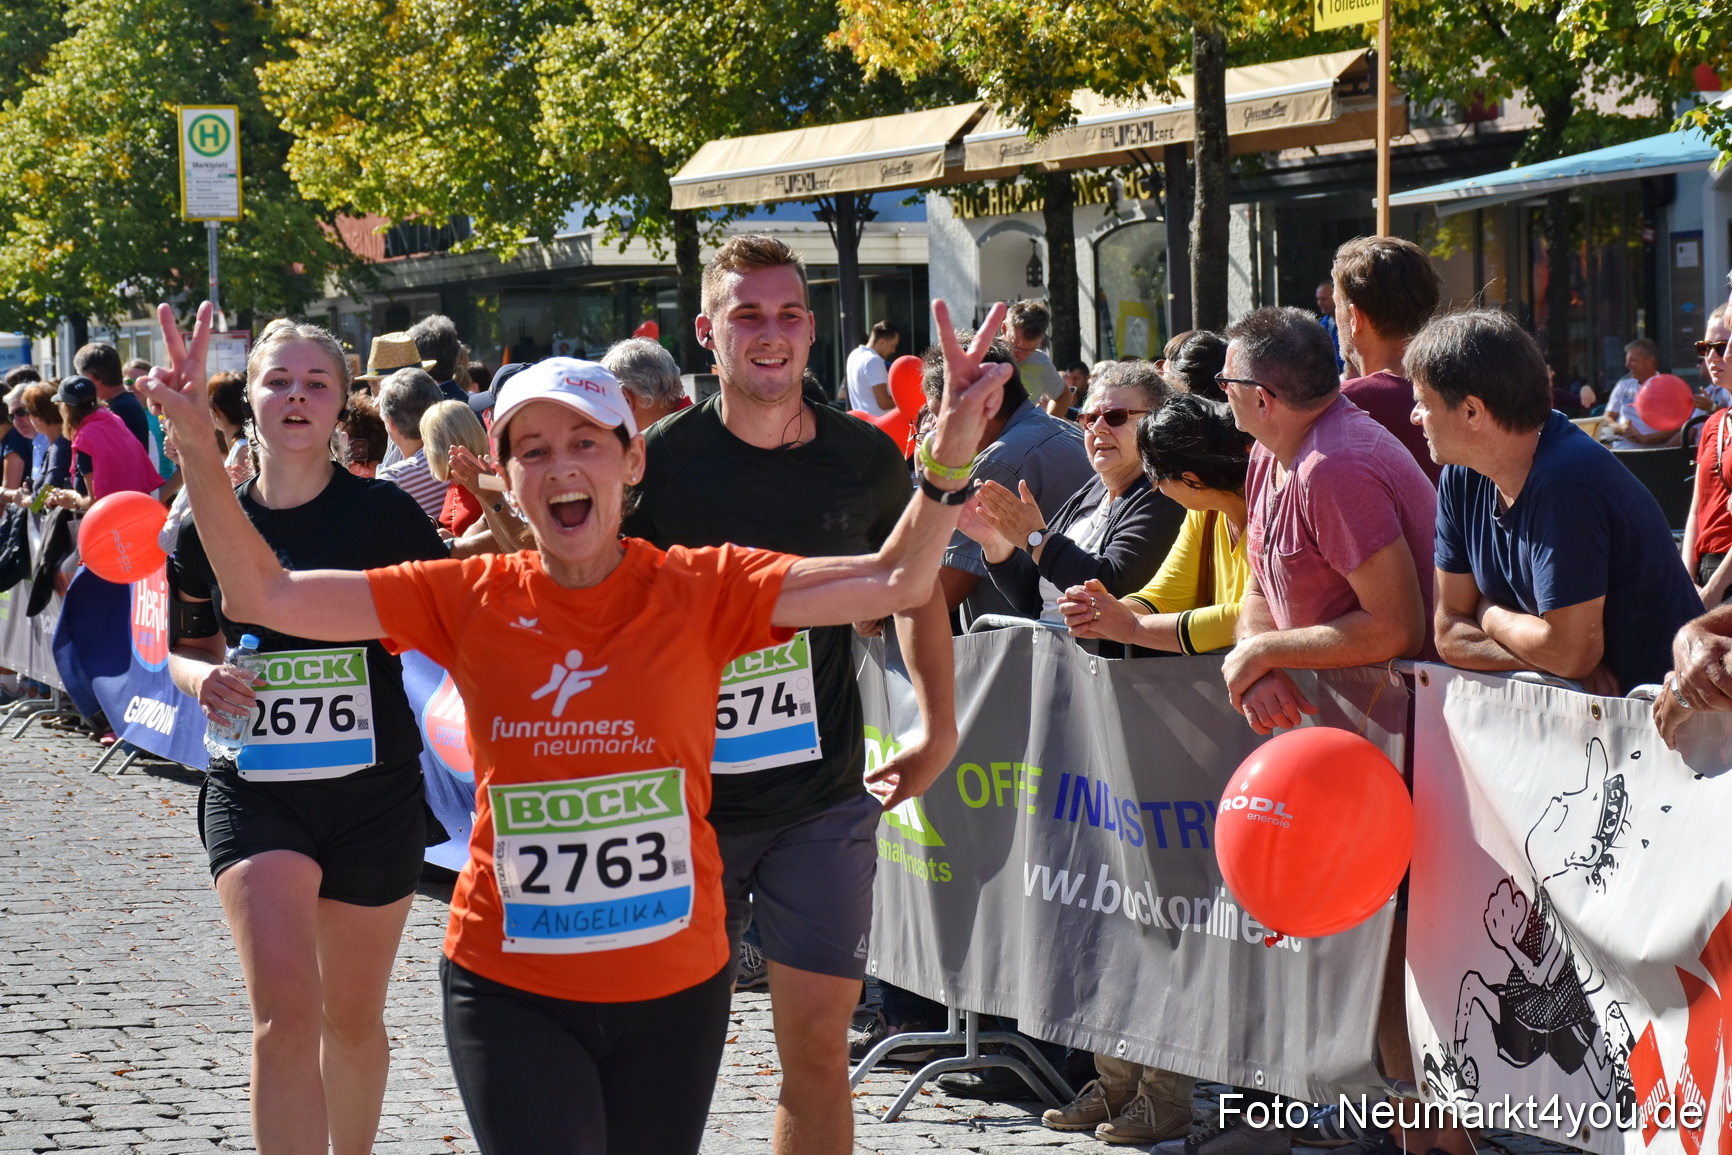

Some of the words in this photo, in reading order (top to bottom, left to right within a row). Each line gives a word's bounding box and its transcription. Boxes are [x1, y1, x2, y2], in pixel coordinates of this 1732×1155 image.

[199, 124, 219, 147] H
[192, 161, 228, 171] Marktplatz
[251, 694, 355, 737] 2676
[715, 681, 798, 731] 674
[491, 716, 635, 742] funrunners
[533, 736, 656, 757] neumarkt
[506, 778, 664, 826] BOCK
[1247, 812, 1291, 829] energie
[518, 832, 667, 894] 2763
[531, 900, 668, 936] ANGELIKA
